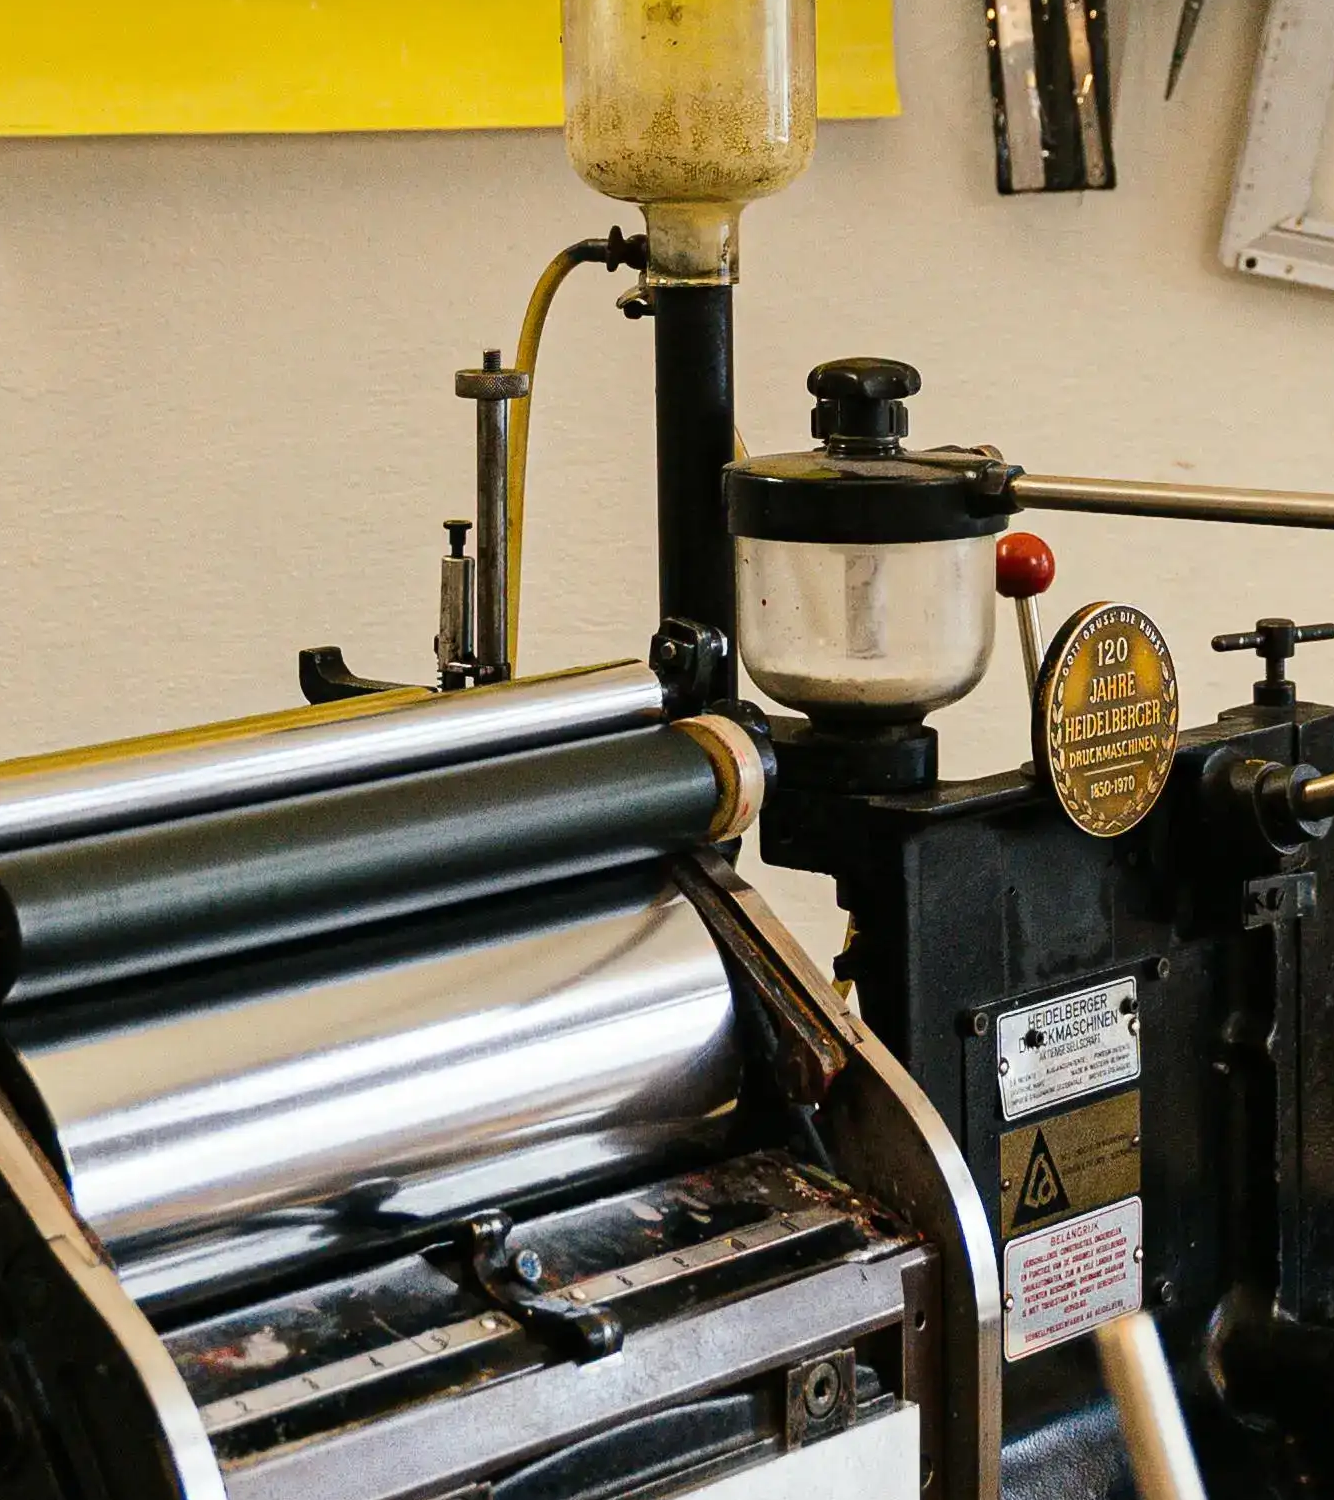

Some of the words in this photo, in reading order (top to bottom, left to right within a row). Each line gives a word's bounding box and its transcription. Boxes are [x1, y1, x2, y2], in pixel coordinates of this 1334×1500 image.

[1120, 611, 1136, 625] DIE
[1097, 637, 1128, 667] 120
[1089, 671, 1136, 703] JAHRE
[1065, 699, 1161, 743] HEIDELBERGER
[1069, 732, 1158, 769] DRUCKMASCHINEN
[1090, 775, 1135, 799] 1850-1970
[1028, 993, 1108, 1030] HEIDELBERGER
[1019, 1011, 1118, 1053] DCKMASCHINEN
[1051, 1221, 1100, 1246] BELANGRIJK
